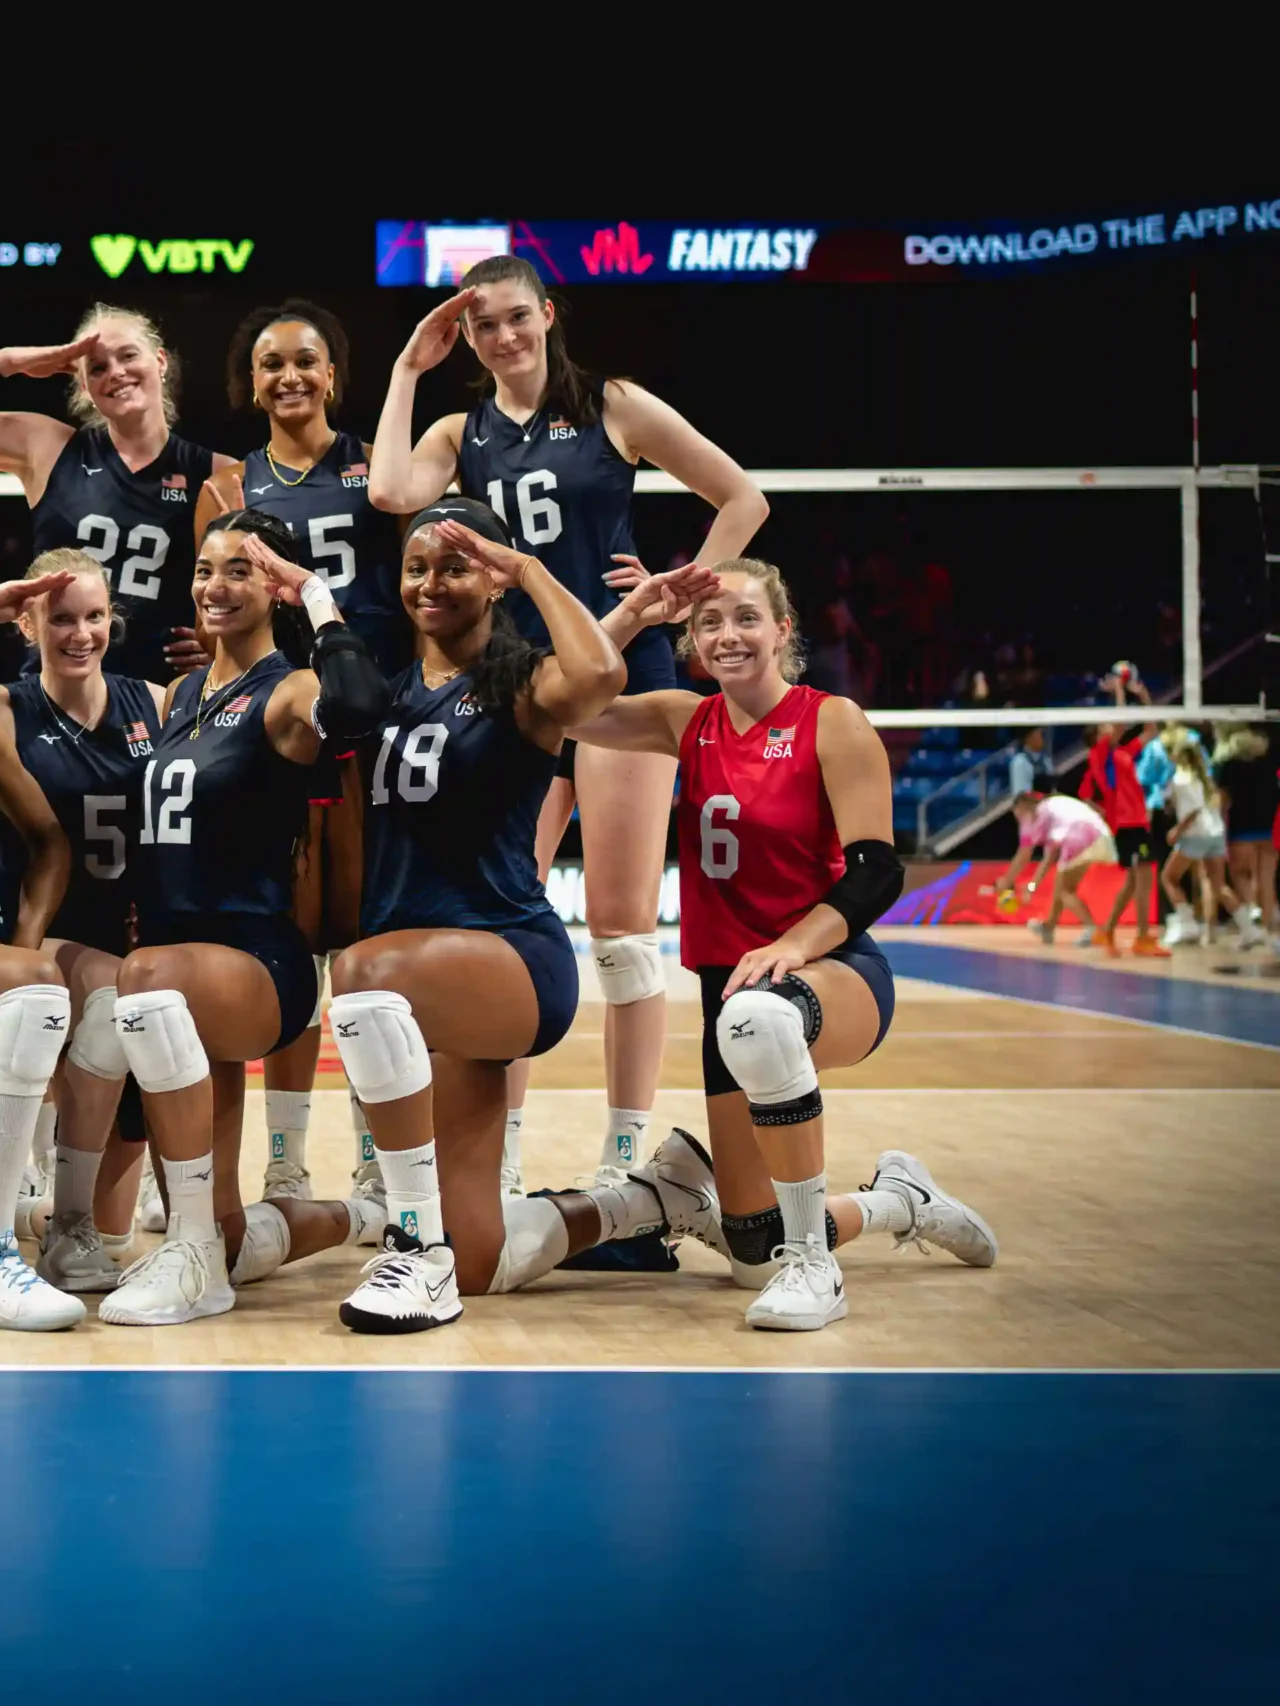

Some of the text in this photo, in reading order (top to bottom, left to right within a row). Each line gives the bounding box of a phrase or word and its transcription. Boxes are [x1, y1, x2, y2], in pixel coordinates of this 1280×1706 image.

[580, 221, 817, 276] VNL FANTASY
[904, 224, 1098, 265] DOWNLOAD
[1101, 213, 1166, 248] THE
[1172, 206, 1238, 241] APP
[24, 242, 61, 266] BY
[139, 239, 254, 273] VBTV
[550, 427, 578, 441] USA
[161, 488, 187, 503] USA
[342, 476, 369, 488] USA
[487, 469, 562, 549] 16
[214, 712, 241, 727] USA
[129, 740, 154, 757] USA
[372, 723, 451, 806] 18
[763, 743, 793, 759] USA
[140, 759, 196, 844] 12
[84, 795, 126, 879] 5
[700, 794, 740, 879] 6
